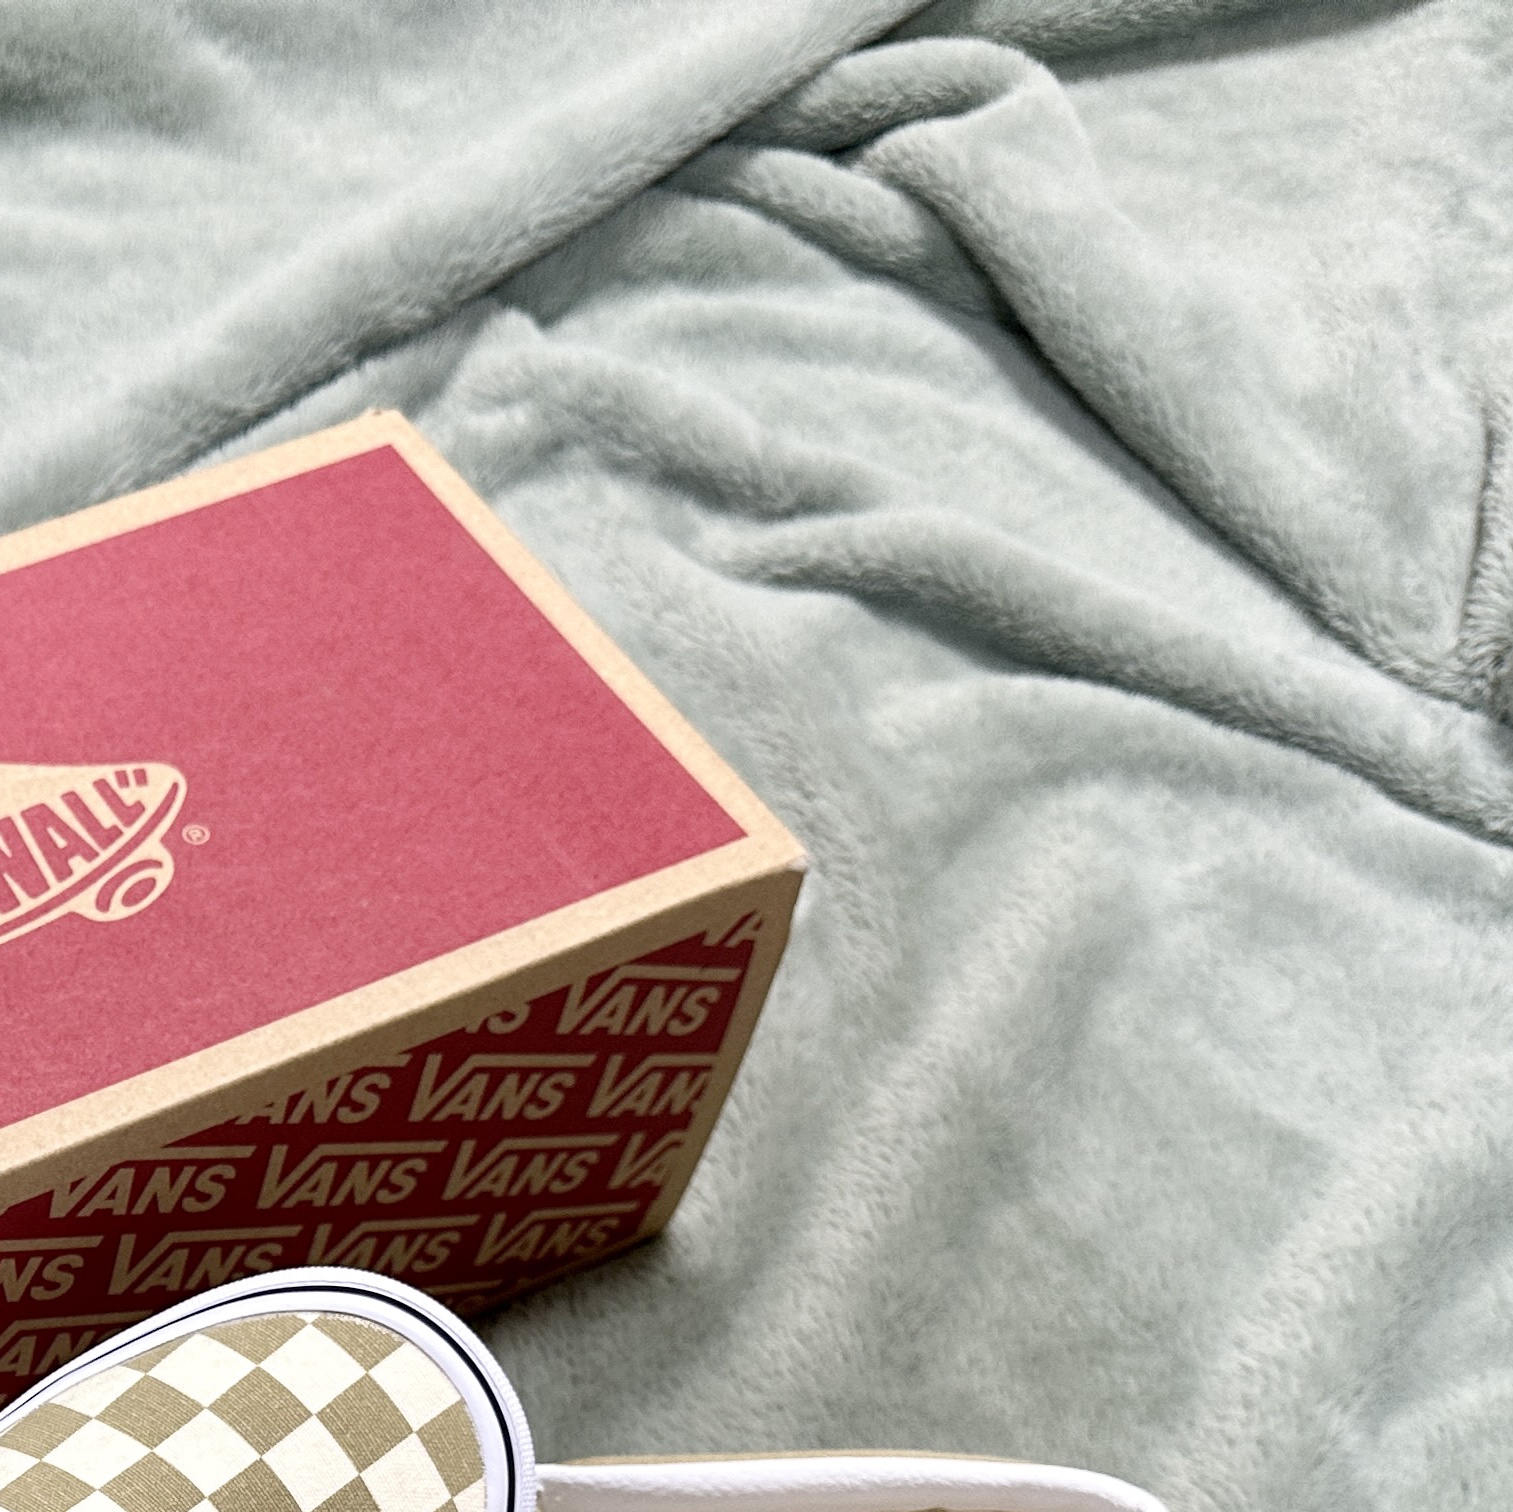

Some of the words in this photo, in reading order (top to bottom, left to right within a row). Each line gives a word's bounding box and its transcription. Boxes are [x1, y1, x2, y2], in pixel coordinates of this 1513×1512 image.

[555, 964, 744, 1037] VANS
[408, 1053, 598, 1122] VANS
[588, 1053, 712, 1118] VAN
[255, 1139, 449, 1210] VANS
[440, 1131, 622, 1201] VANS
[107, 1224, 304, 1296] VANS
[306, 1213, 482, 1275] VANS
[473, 1201, 641, 1267] VANS
